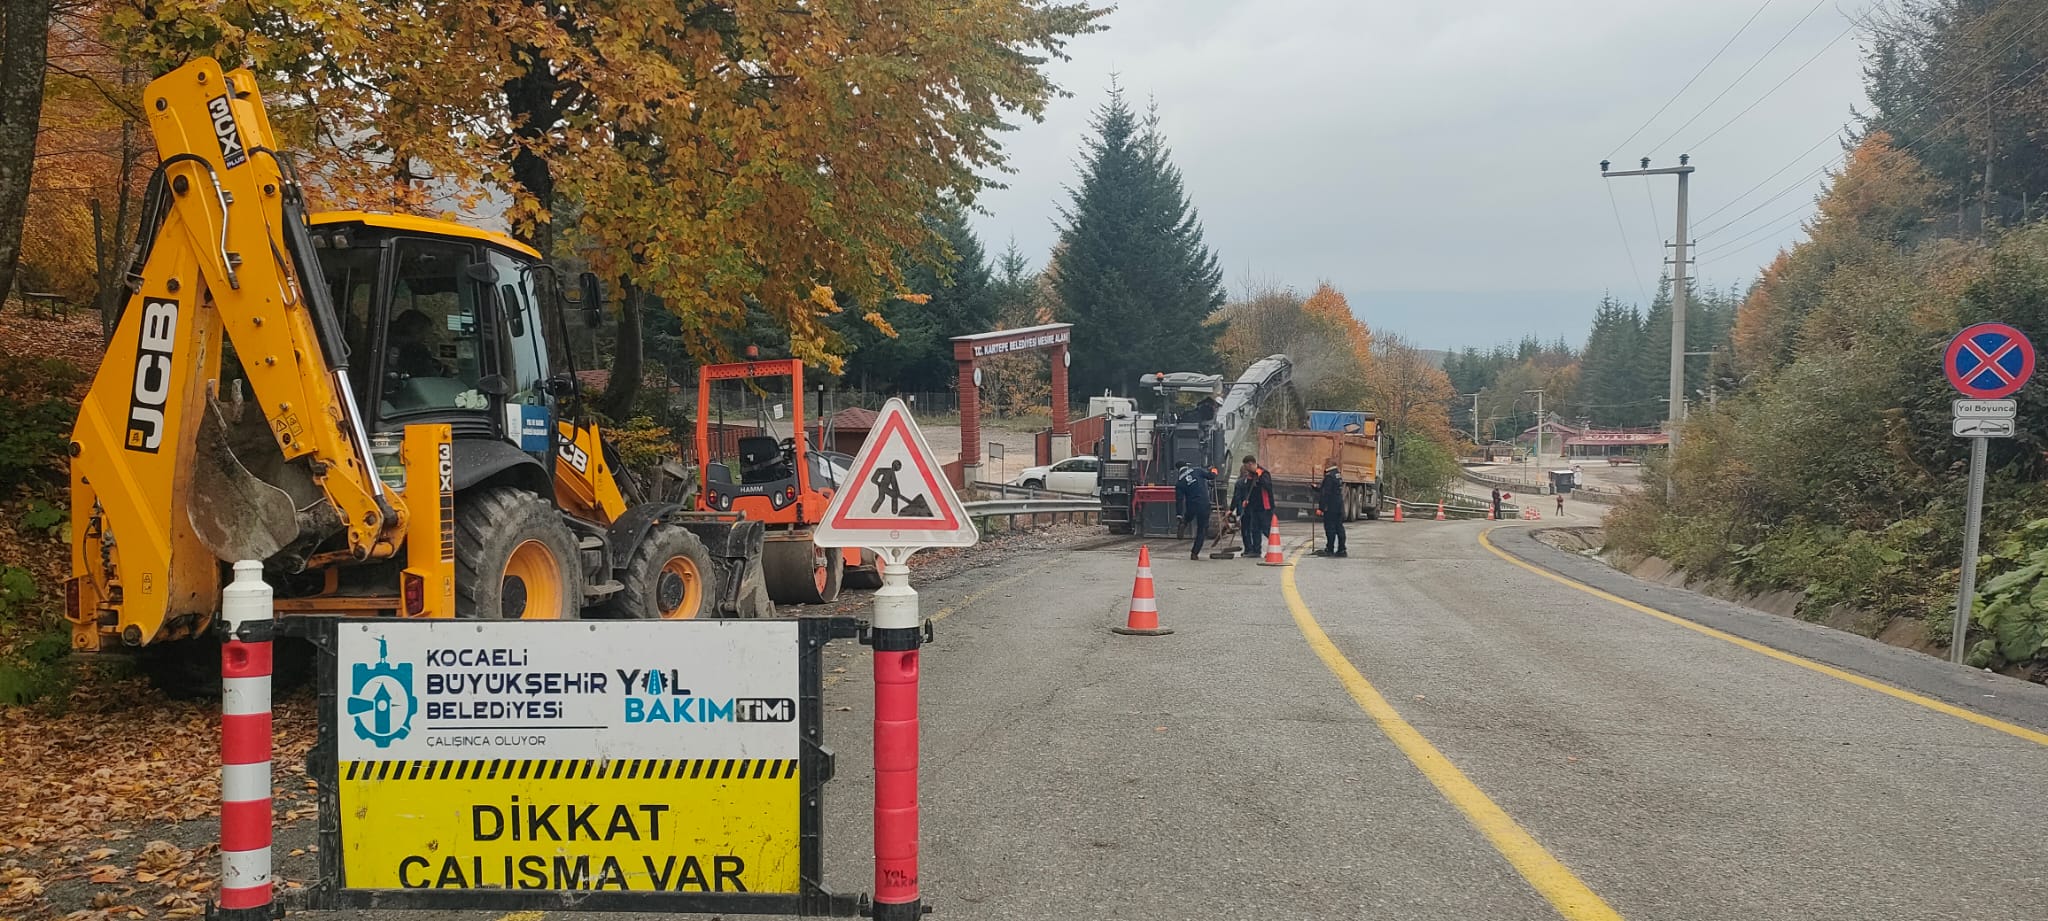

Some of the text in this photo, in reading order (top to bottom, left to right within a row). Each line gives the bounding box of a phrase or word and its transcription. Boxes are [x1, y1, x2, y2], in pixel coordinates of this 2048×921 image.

[209, 97, 242, 156] 3CX
[226, 155, 245, 168] PLUS
[984, 342, 1009, 355] KARTEPE
[132, 302, 178, 449] JCB
[1975, 405, 2014, 413] Boyunca
[439, 444, 451, 491] 3CX
[558, 434, 588, 474] CB
[616, 669, 691, 696] YOL
[625, 697, 734, 723] BAKIM
[426, 735, 546, 747] ÇALIŞINCA OLUYOR
[472, 795, 669, 842] DİKKAT
[643, 855, 748, 892] VAR
